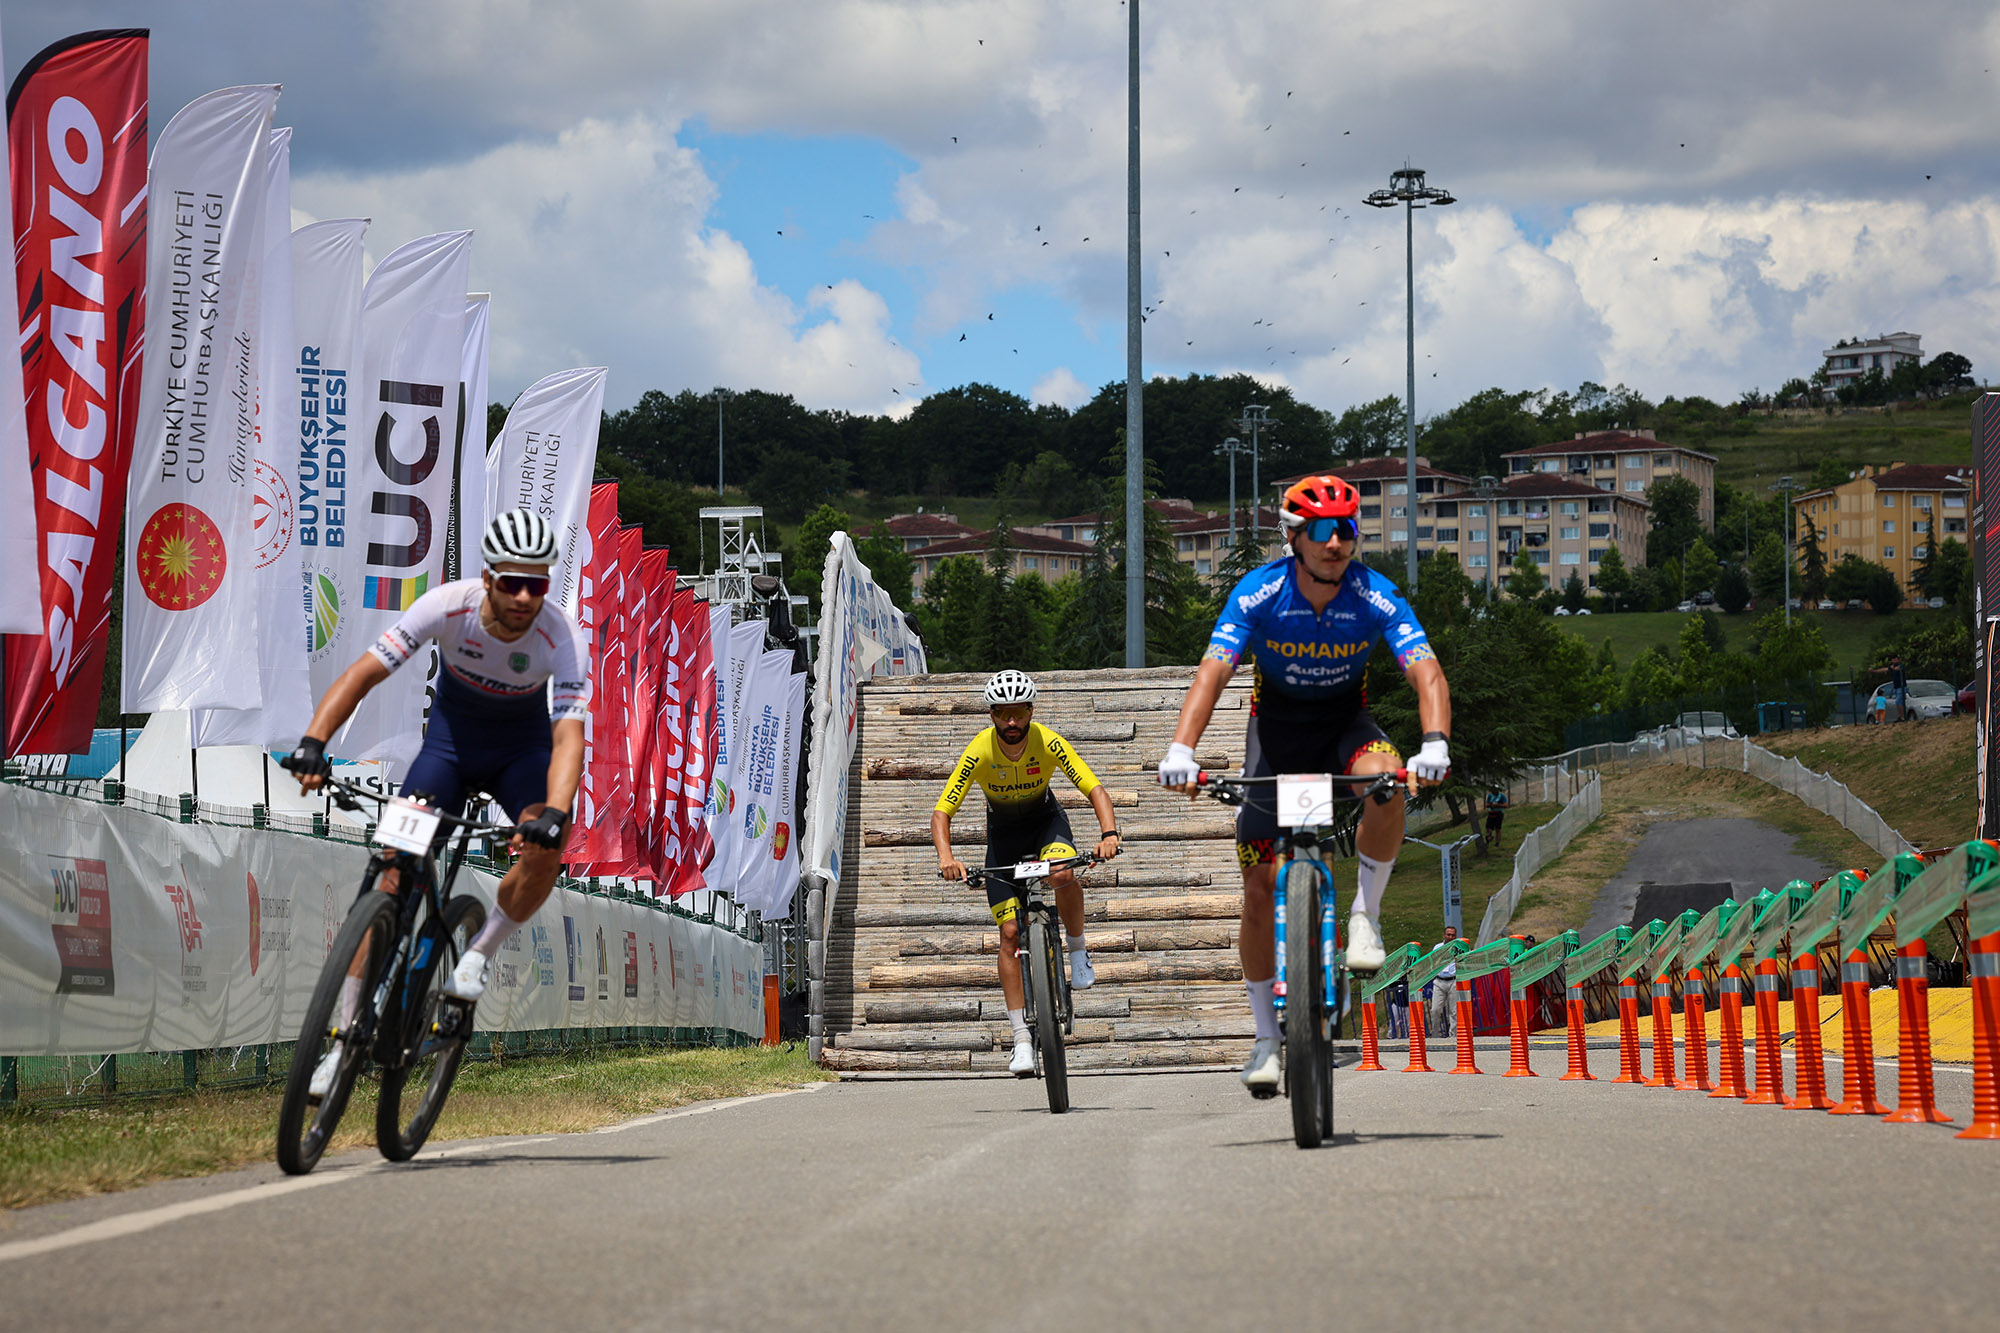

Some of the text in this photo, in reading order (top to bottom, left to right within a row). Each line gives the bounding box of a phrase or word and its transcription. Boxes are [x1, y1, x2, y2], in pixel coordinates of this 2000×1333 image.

[161, 190, 195, 483] TÜRKİYE CUMHURİYETİ
[186, 193, 224, 484] CUMHURBAŞKANLIĞI
[46, 95, 107, 691] SALCANO
[227, 330, 253, 487] Himayelerinde
[321, 368, 347, 548] BELEDİYESİ
[366, 379, 445, 568] UCI
[518, 430, 541, 511] HURİYETİ
[538, 433, 561, 520] ŞKANLIĞI
[555, 521, 579, 612] imayelerinde
[1266, 639, 1370, 659] ROMANIA
[754, 704, 773, 793] BÜYÜKŞEHİR
[763, 715, 780, 796] BELEDİYESİ
[399, 815, 420, 836] 11
[1297, 789, 1313, 809] 6
[1023, 864, 1042, 873] 22
